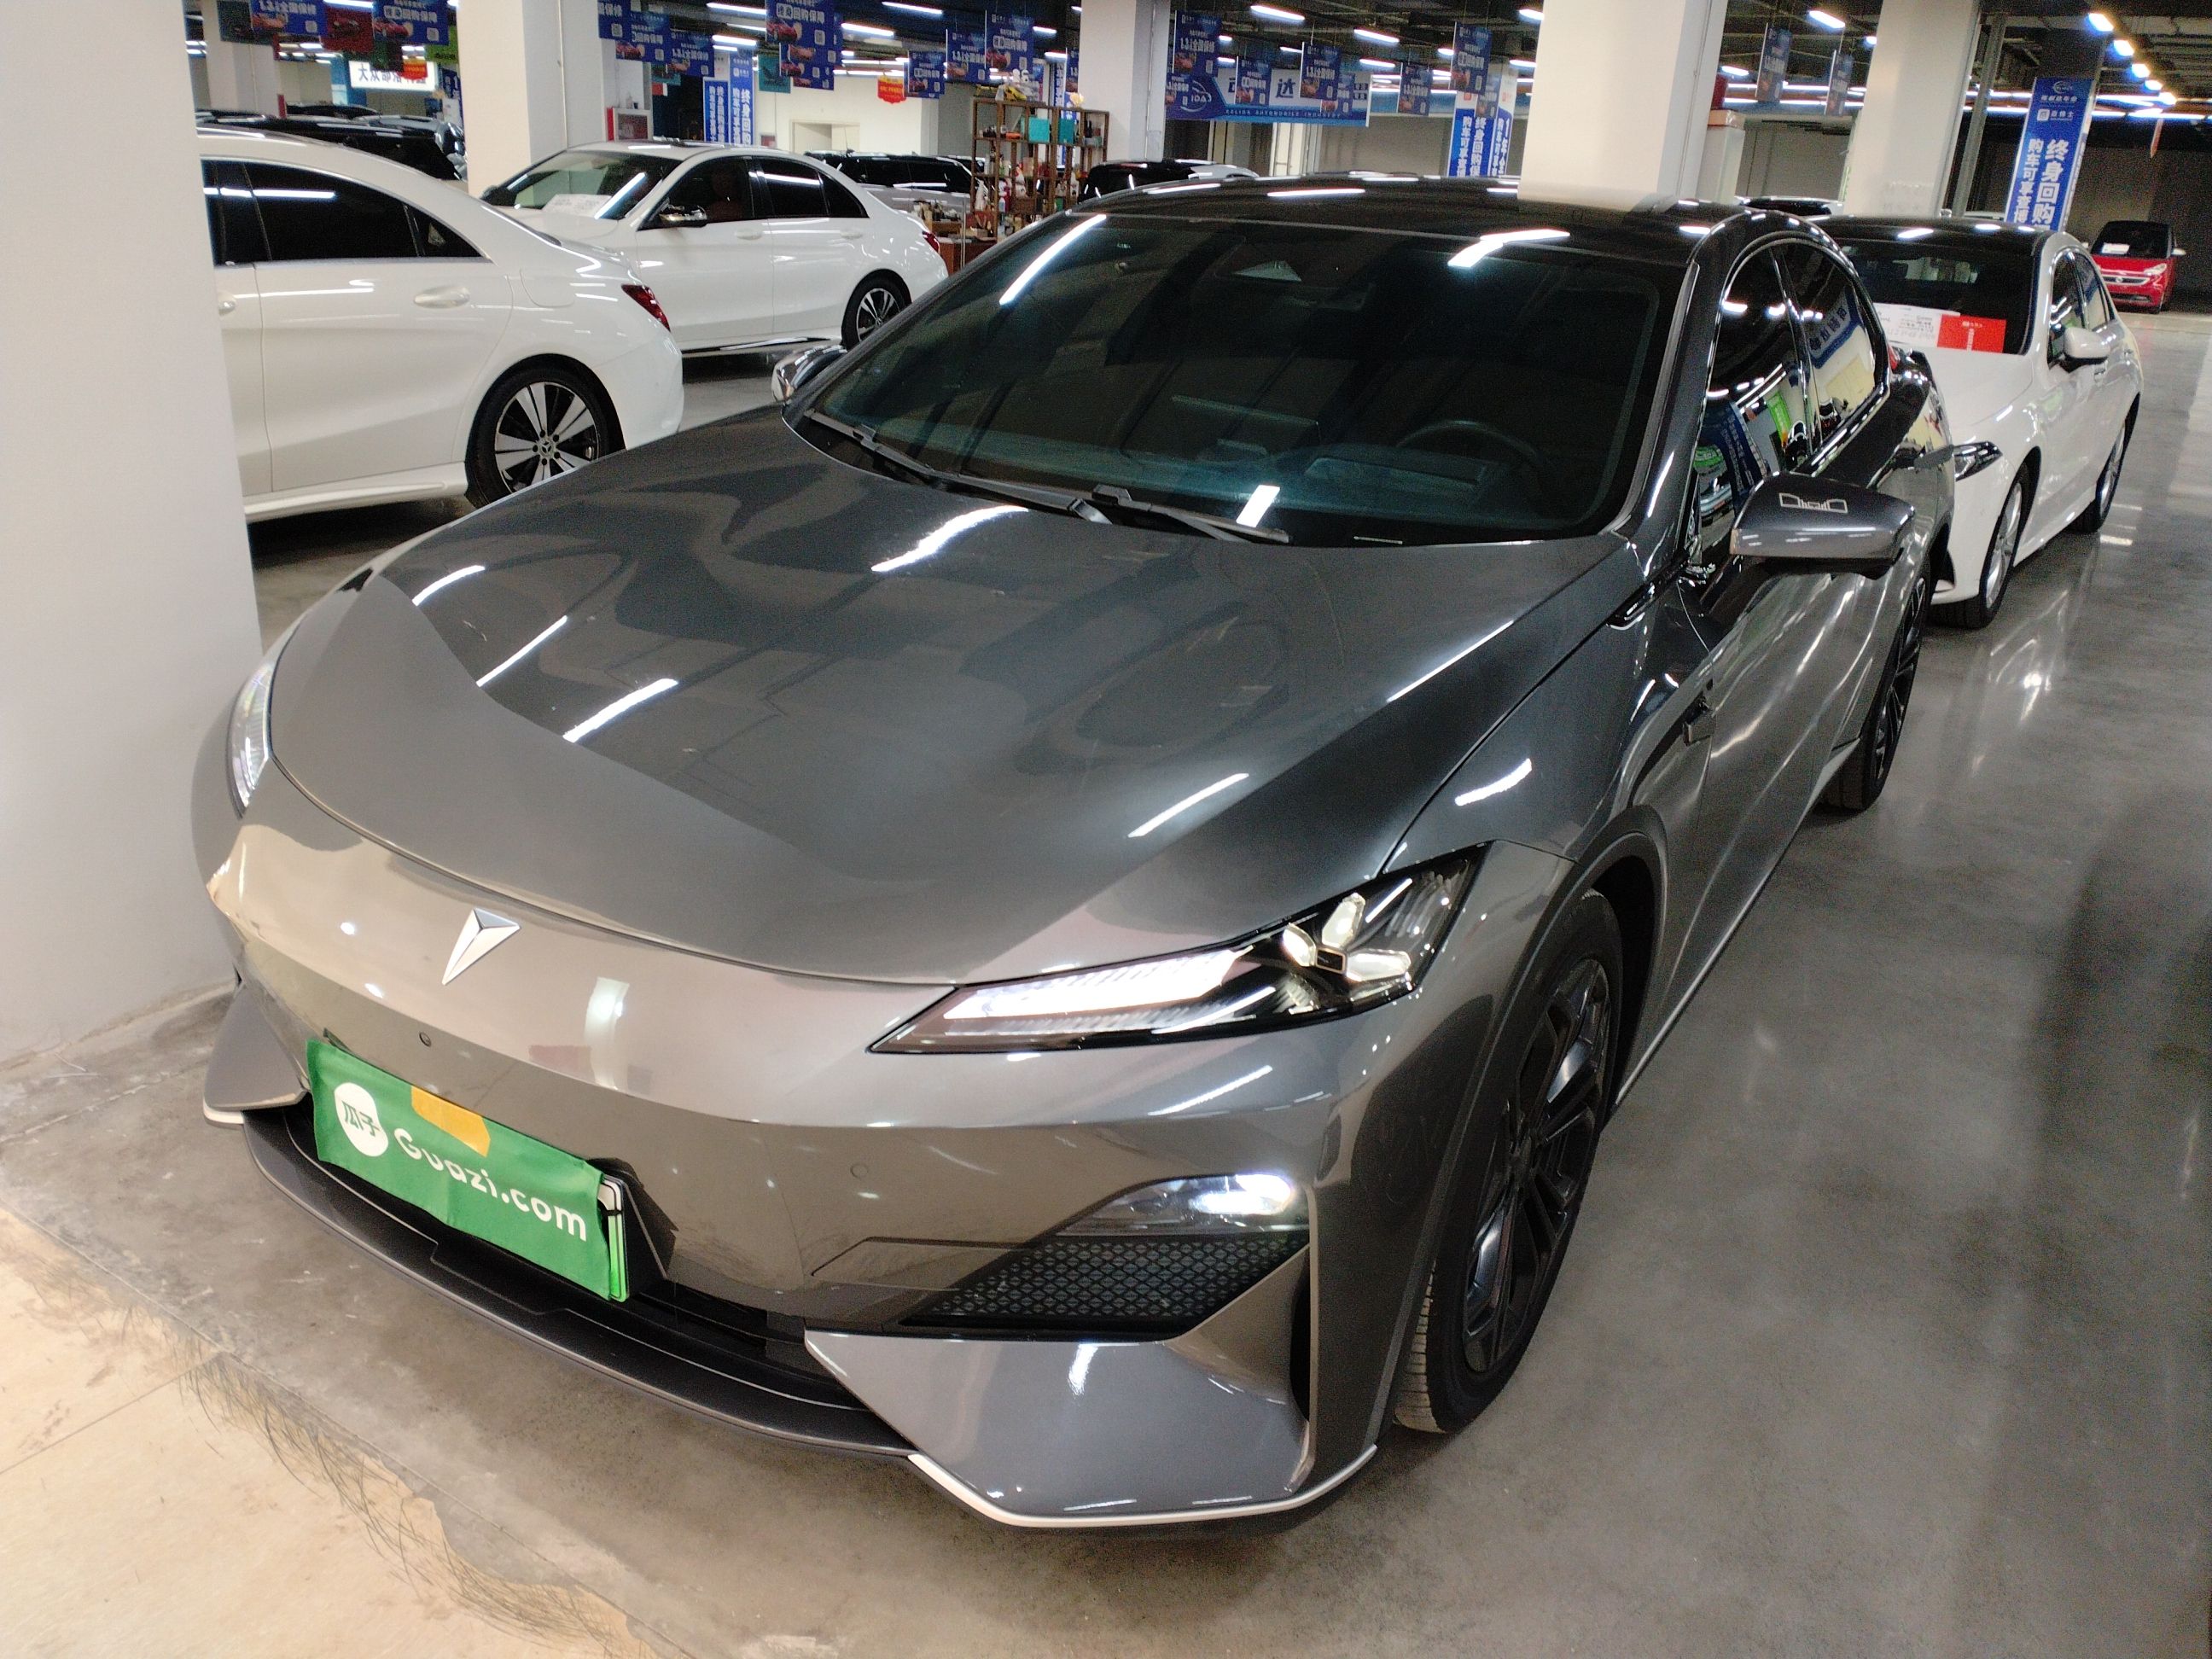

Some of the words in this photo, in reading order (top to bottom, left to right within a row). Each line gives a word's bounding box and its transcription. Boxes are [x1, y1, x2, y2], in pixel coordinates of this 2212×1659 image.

[2032, 138, 2069, 230] 终身回购
[341, 1099, 381, 1138] 瓜子
[393, 1127, 587, 1243] Guazi.com
